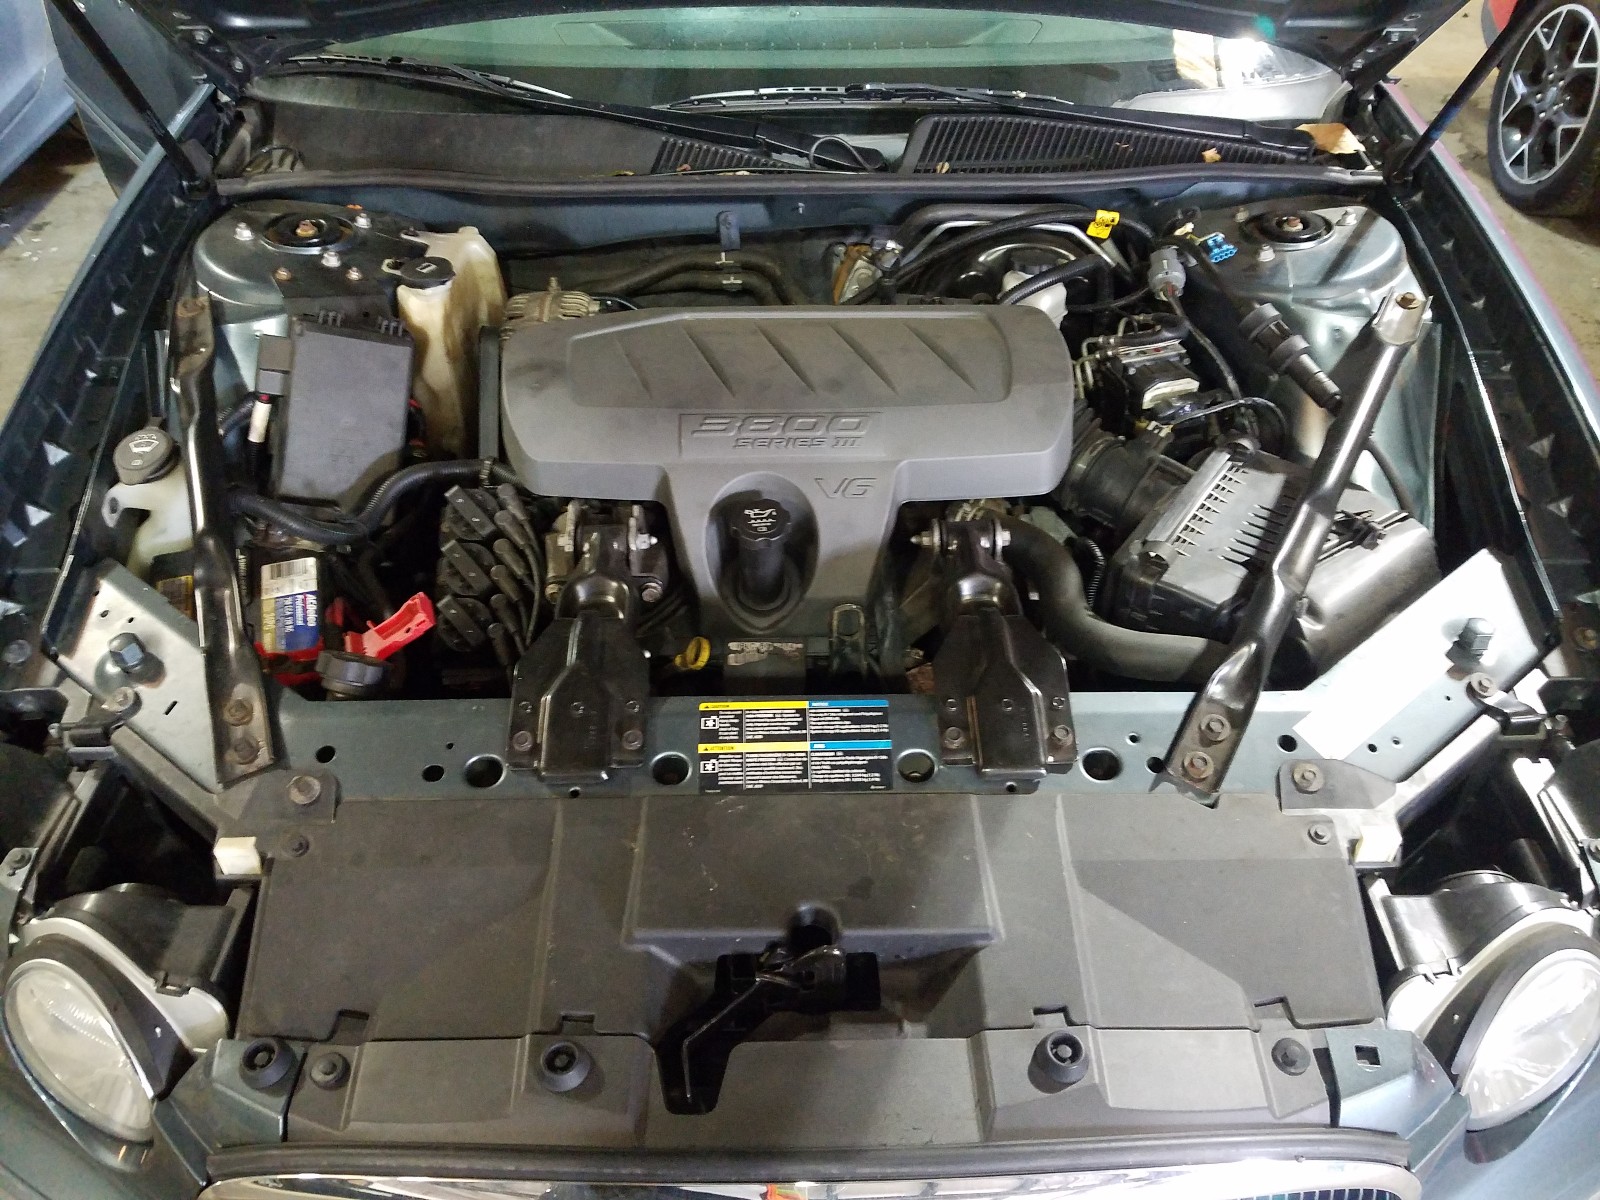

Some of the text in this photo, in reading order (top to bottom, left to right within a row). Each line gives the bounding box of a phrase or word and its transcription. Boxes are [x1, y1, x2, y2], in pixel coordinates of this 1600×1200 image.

[691, 415, 870, 436] 3800
[732, 437, 865, 449] SERIES III
[813, 477, 878, 499] V6
[306, 594, 318, 627] ACDelco
